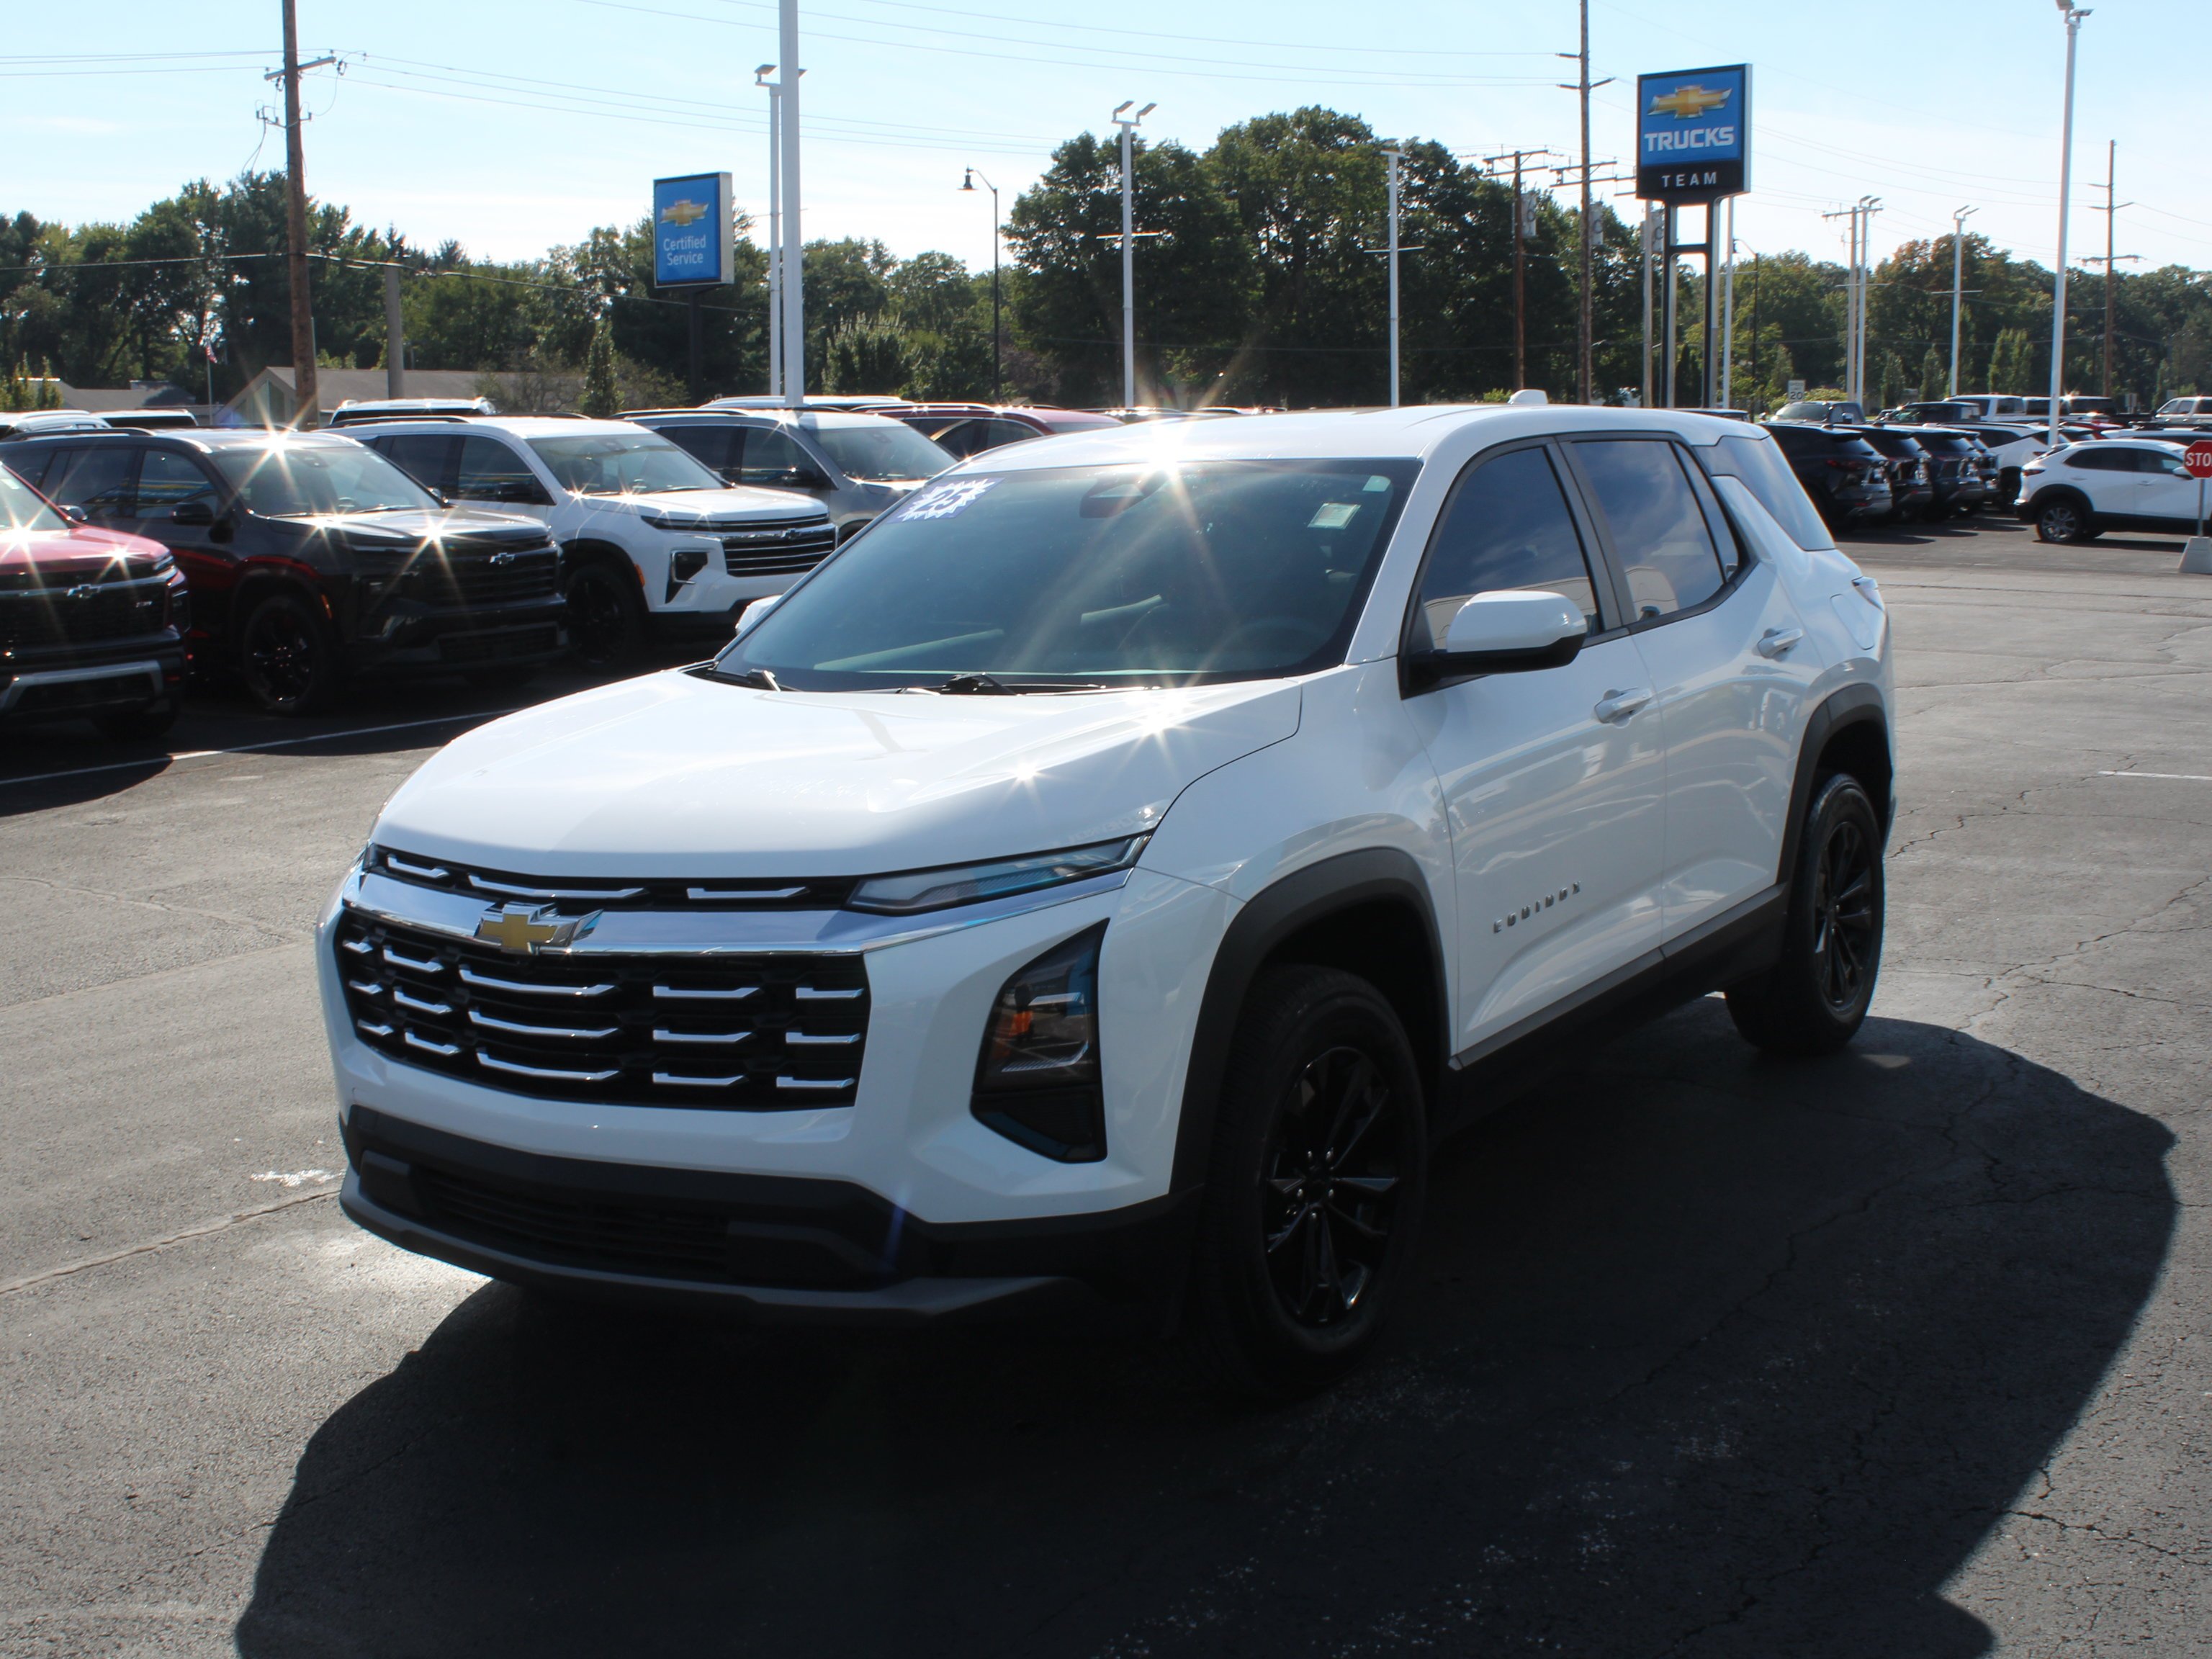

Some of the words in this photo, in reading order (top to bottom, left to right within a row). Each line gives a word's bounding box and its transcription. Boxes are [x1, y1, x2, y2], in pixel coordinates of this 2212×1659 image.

[1644, 126, 1735, 152] TRUCKS
[1661, 171, 1717, 188] TEAM
[663, 235, 706, 251] Certified
[667, 251, 703, 266] Service
[2185, 452, 2212, 467] STO
